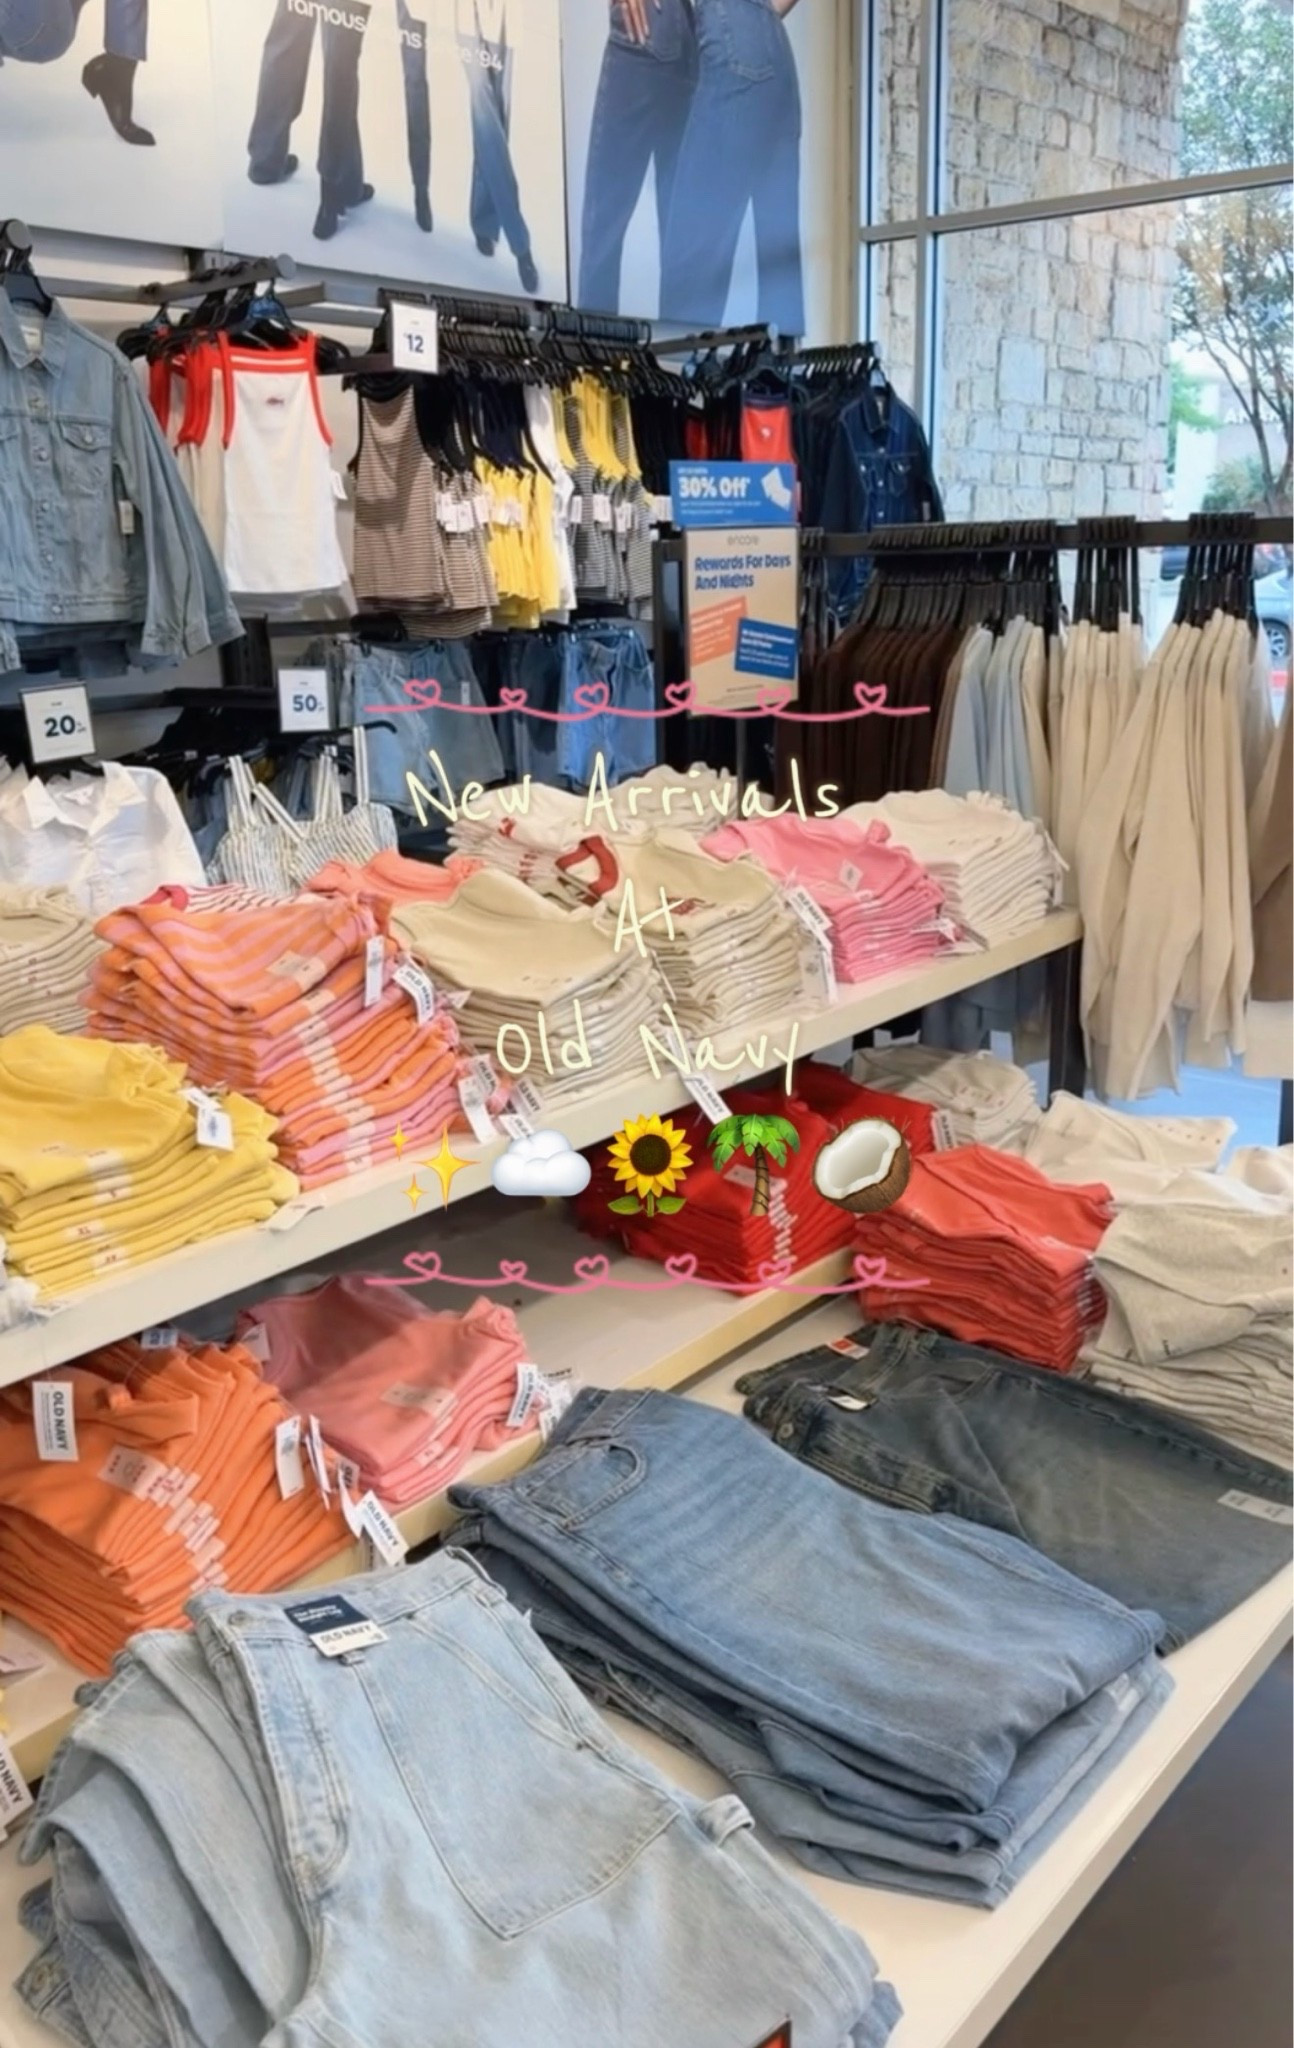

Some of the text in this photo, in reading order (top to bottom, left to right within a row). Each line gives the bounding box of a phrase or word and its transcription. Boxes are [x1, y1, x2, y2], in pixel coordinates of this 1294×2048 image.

[678, 476, 718, 499] 30%
[695, 553, 792, 571] Rewards For Days
[695, 573, 755, 590] And Nights
[293, 694, 318, 712] 50
[44, 714, 76, 738] 20
[52, 1391, 69, 1451] OLD NAVY
[366, 1500, 400, 1547] OLD NAVY
[320, 1624, 372, 1644] OLD NAVY
[0, 1769, 23, 1804] NAVY
